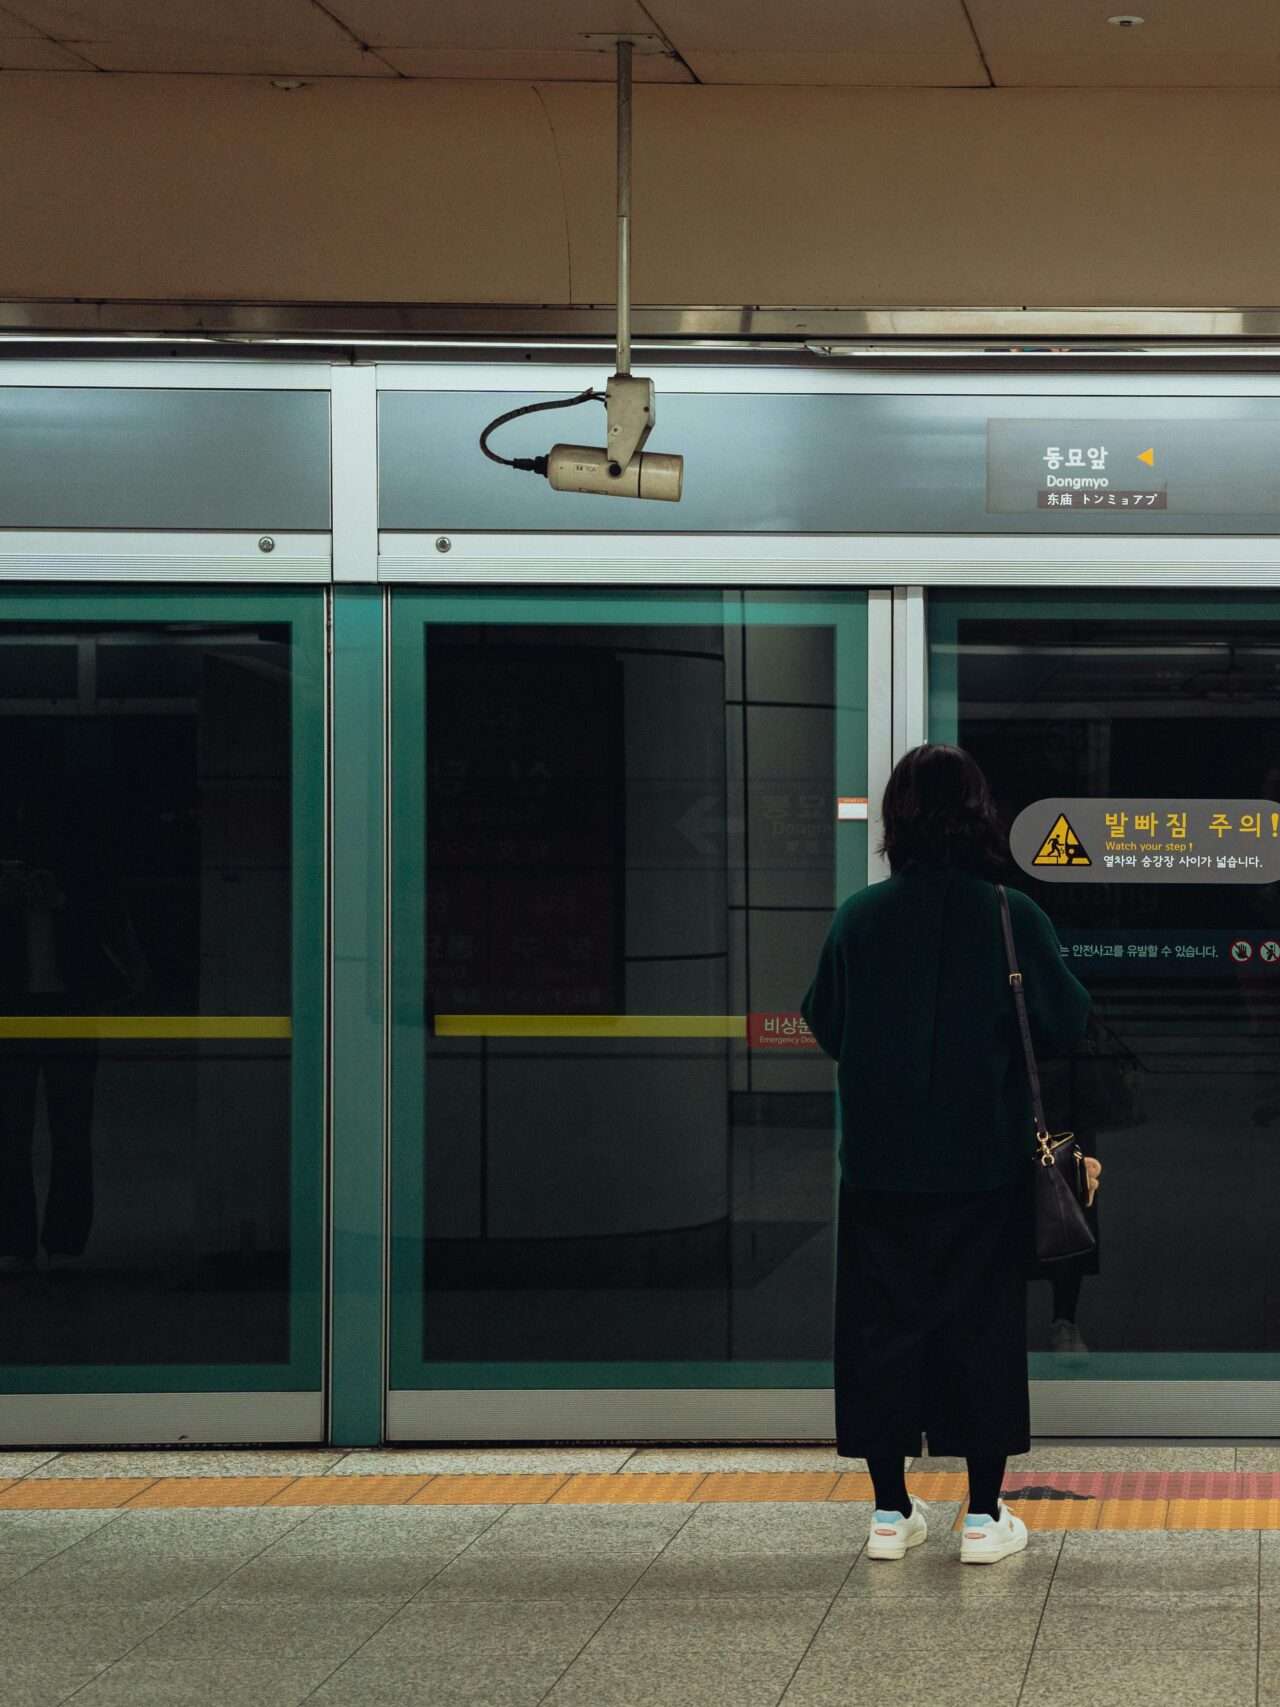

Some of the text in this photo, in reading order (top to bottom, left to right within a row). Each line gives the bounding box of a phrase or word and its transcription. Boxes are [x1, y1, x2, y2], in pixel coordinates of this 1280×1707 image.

[1042, 446, 1109, 470] 동묘앞
[1046, 474, 1109, 490] Dongmyo
[1047, 492, 1073, 506] 东庙
[1105, 812, 1280, 839] 발빠짐 주의!
[1105, 841, 1137, 851] Watch
[1140, 843, 1162, 854] your
[1103, 855, 1137, 868] 열차와
[1141, 855, 1175, 868] 승강장
[1178, 855, 1212, 868] 사이가
[1160, 945, 1173, 958] 수
[1175, 945, 1219, 958] 있습니다.
